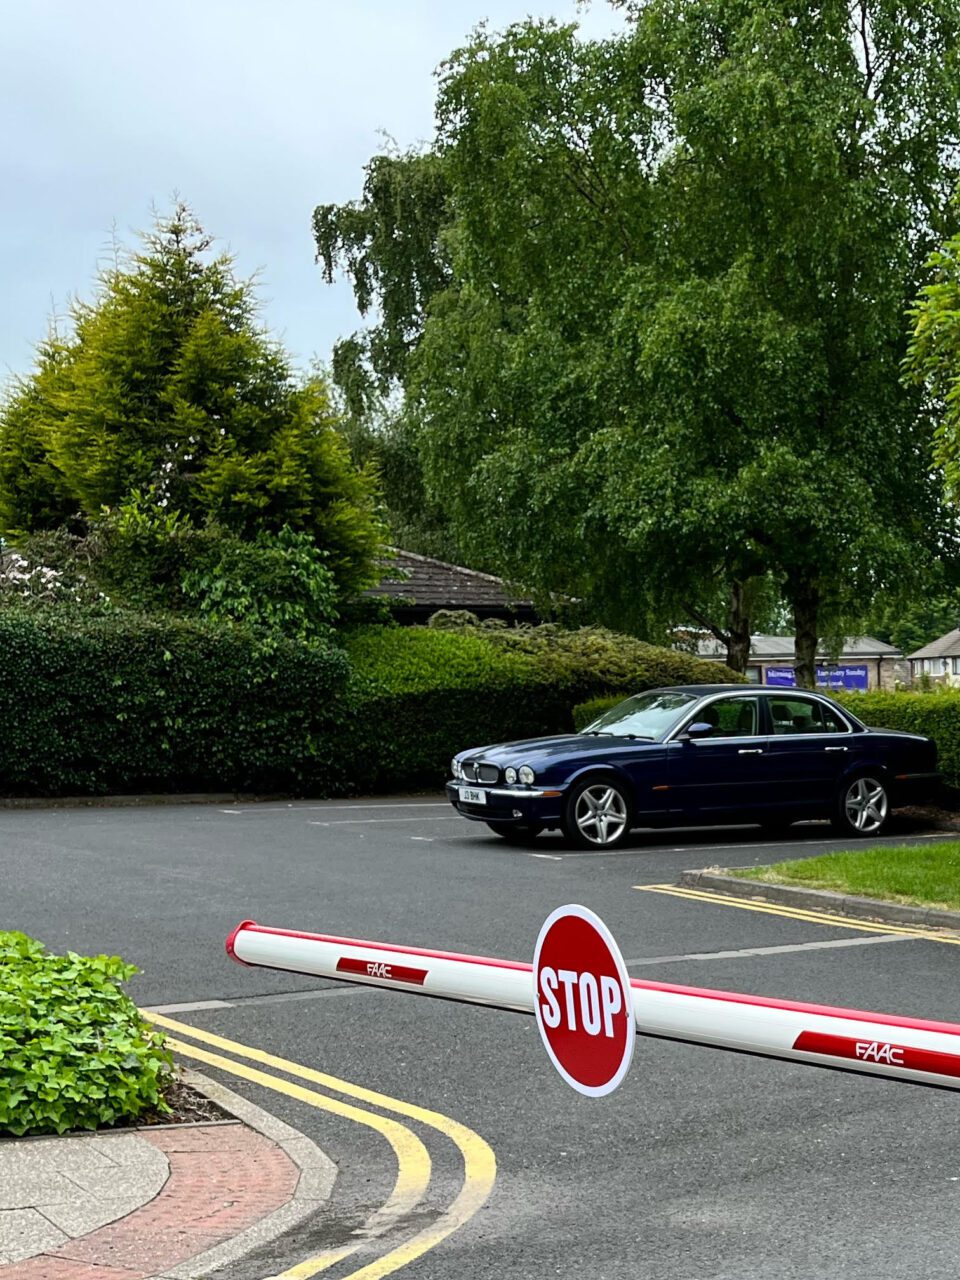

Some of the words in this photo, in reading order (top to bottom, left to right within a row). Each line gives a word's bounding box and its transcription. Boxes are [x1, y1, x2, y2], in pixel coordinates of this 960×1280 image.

[845, 669, 866, 677] Sunday
[366, 962, 392, 978] FAAC
[540, 966, 622, 1038] STOP
[855, 1042, 904, 1064] FAAC
